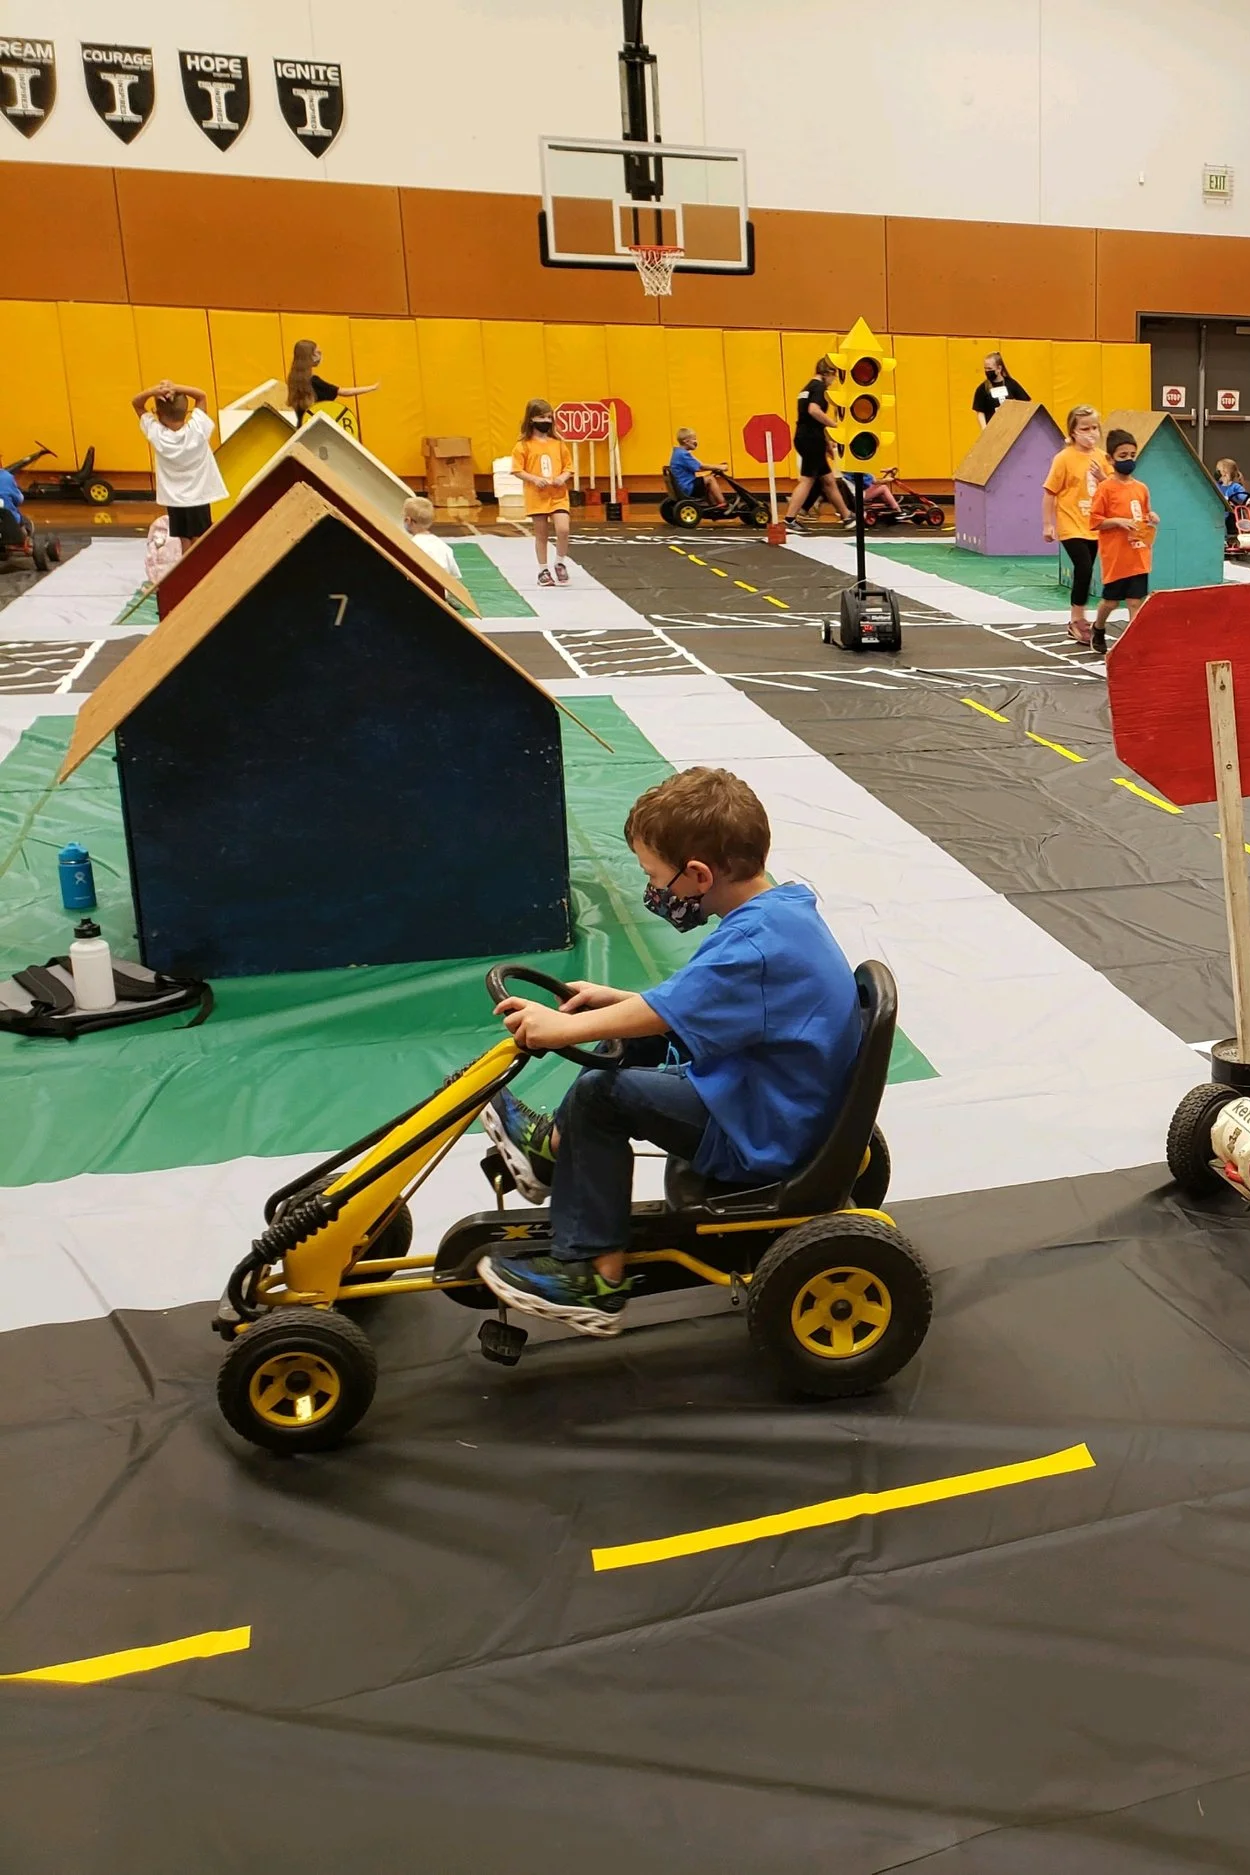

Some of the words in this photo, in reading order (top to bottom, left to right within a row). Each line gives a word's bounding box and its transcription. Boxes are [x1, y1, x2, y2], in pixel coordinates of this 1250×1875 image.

[83, 49, 153, 65] COURAGE
[186, 54, 242, 74] HOPE
[276, 61, 340, 81] IGNITE
[1209, 174, 1226, 190] EXIT
[1166, 393, 1181, 401] STOP
[1221, 397, 1235, 405] STOP
[557, 410, 591, 433] STOP
[591, 410, 610, 433] OP
[327, 593, 349, 626] 7
